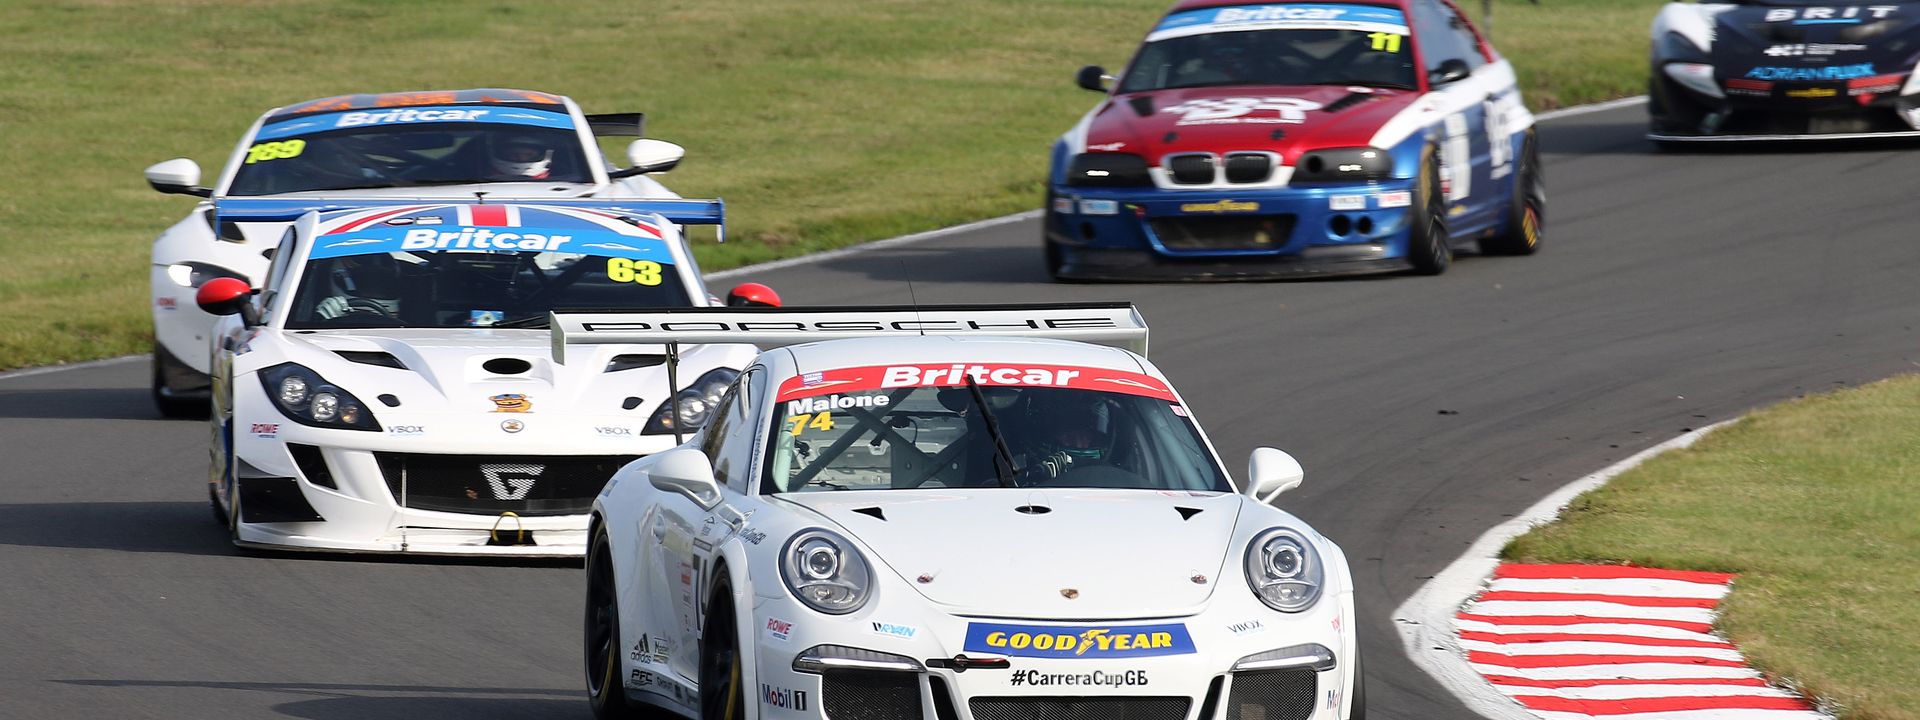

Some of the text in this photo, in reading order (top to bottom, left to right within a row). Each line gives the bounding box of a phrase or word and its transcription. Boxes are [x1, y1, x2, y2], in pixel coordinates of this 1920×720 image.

[1214, 6, 1346, 23] Britcar
[1764, 6, 1900, 22] BRIT
[1368, 32, 1401, 53] 11
[336, 110, 488, 127] Britcar
[245, 139, 306, 164] 189
[400, 229, 571, 251] Britcar
[607, 257, 662, 286] 63
[581, 317, 1117, 332] PORSCHE
[880, 365, 1080, 389] Britcar
[788, 394, 890, 417] Malone
[786, 411, 834, 437] 74
[767, 618, 792, 634] ROWE
[630, 650, 652, 664] adidas
[631, 668, 653, 683] PFC
[1010, 670, 1149, 689] #CarreraCupGB
[762, 683, 793, 710] Mobil
